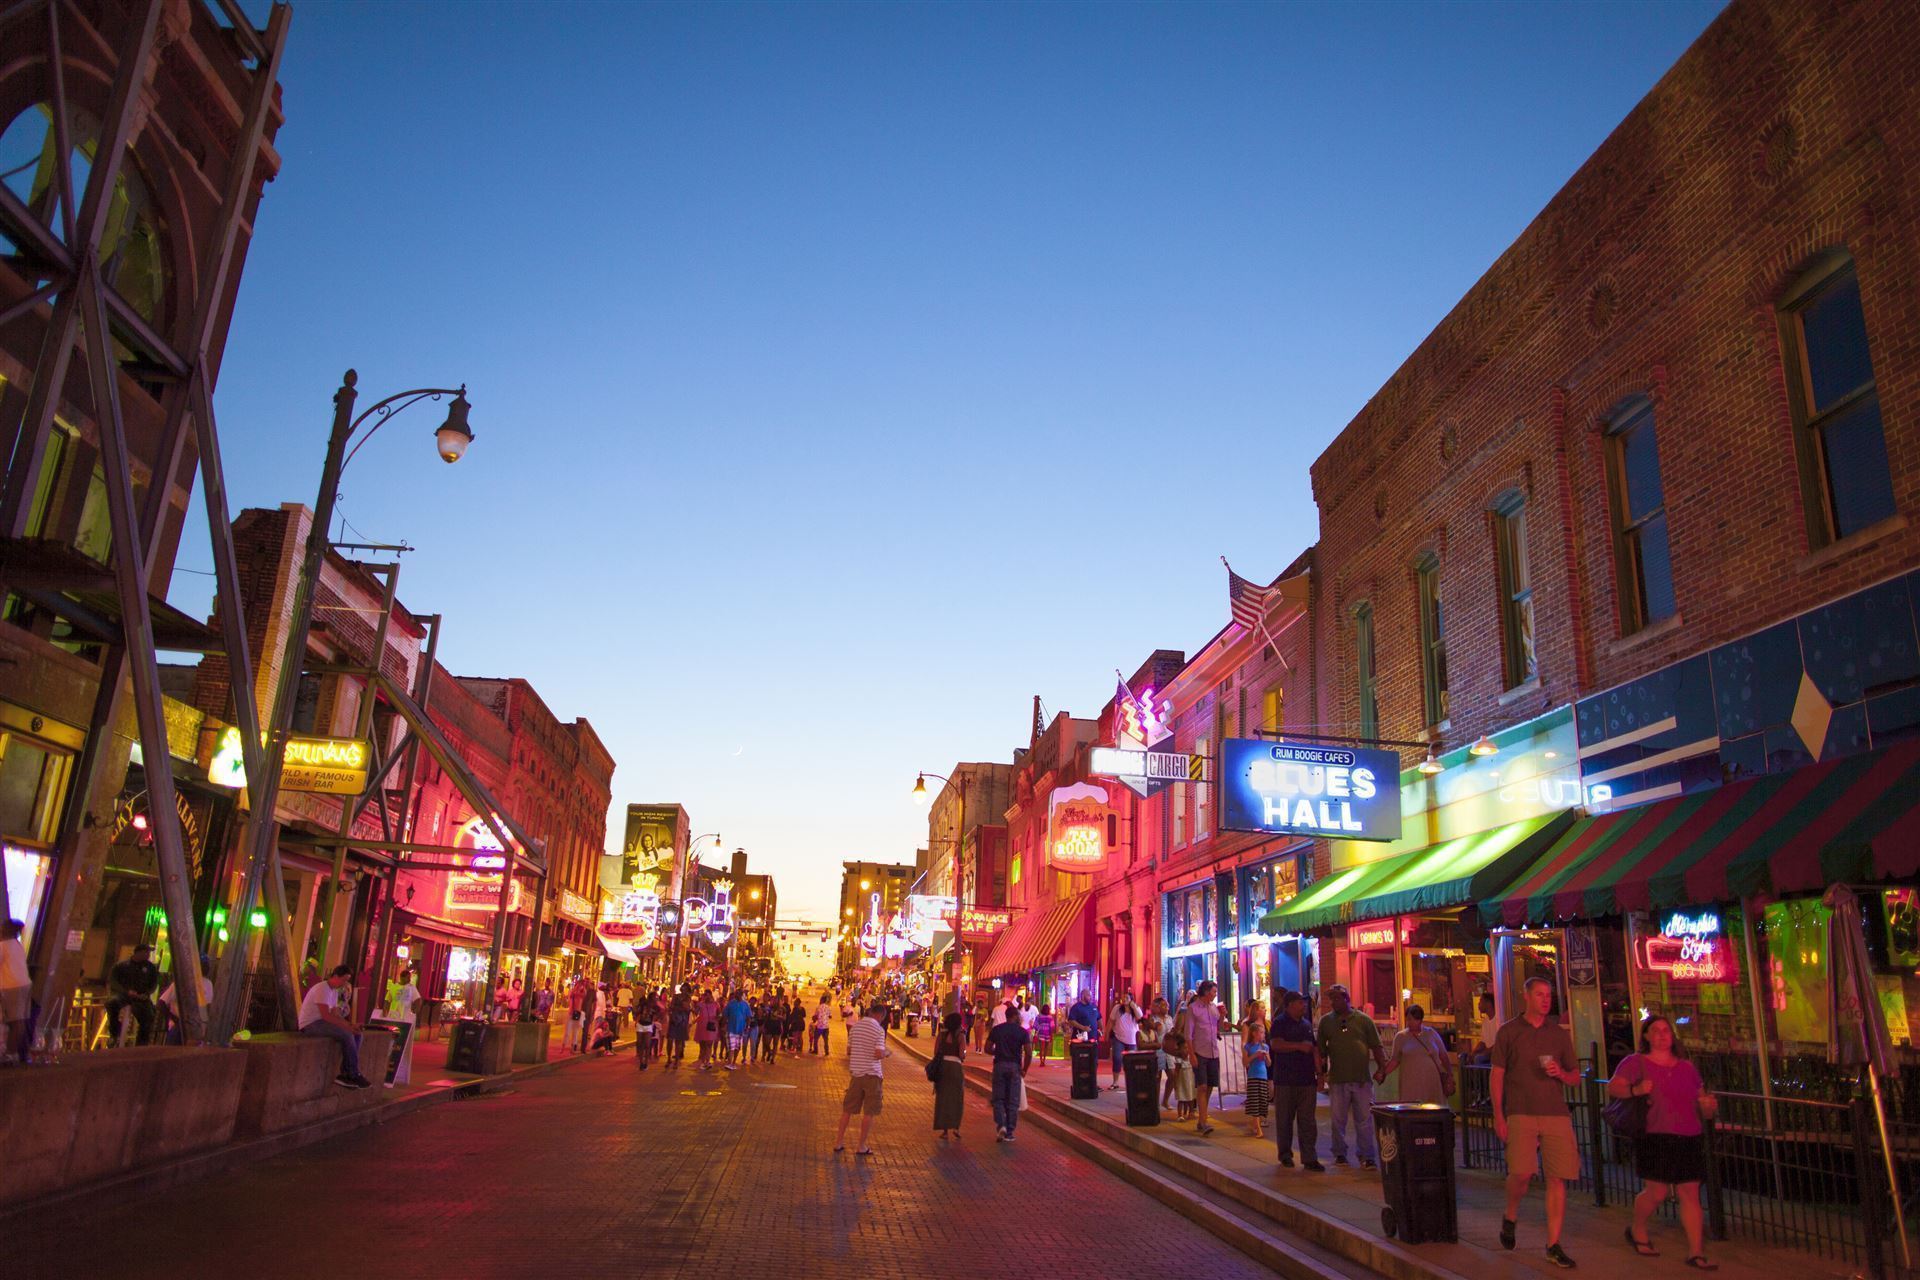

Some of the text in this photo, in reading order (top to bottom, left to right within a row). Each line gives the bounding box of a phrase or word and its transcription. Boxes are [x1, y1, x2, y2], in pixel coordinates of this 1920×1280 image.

[1276, 748, 1350, 763] RUM BOOGIE CAFE'S
[1149, 754, 1187, 777] CARGO
[282, 768, 356, 782] RLD FAMOUS
[1250, 760, 1377, 799] BLUES
[282, 777, 334, 789] IRISH BAR
[1263, 796, 1363, 831] HALL
[1068, 829, 1098, 842] TAP
[1056, 841, 1101, 857] ROOM
[1665, 912, 1719, 941] Memphis
[1383, 928, 1394, 943] TO
[1673, 963, 1722, 978] BBQ RIBS
